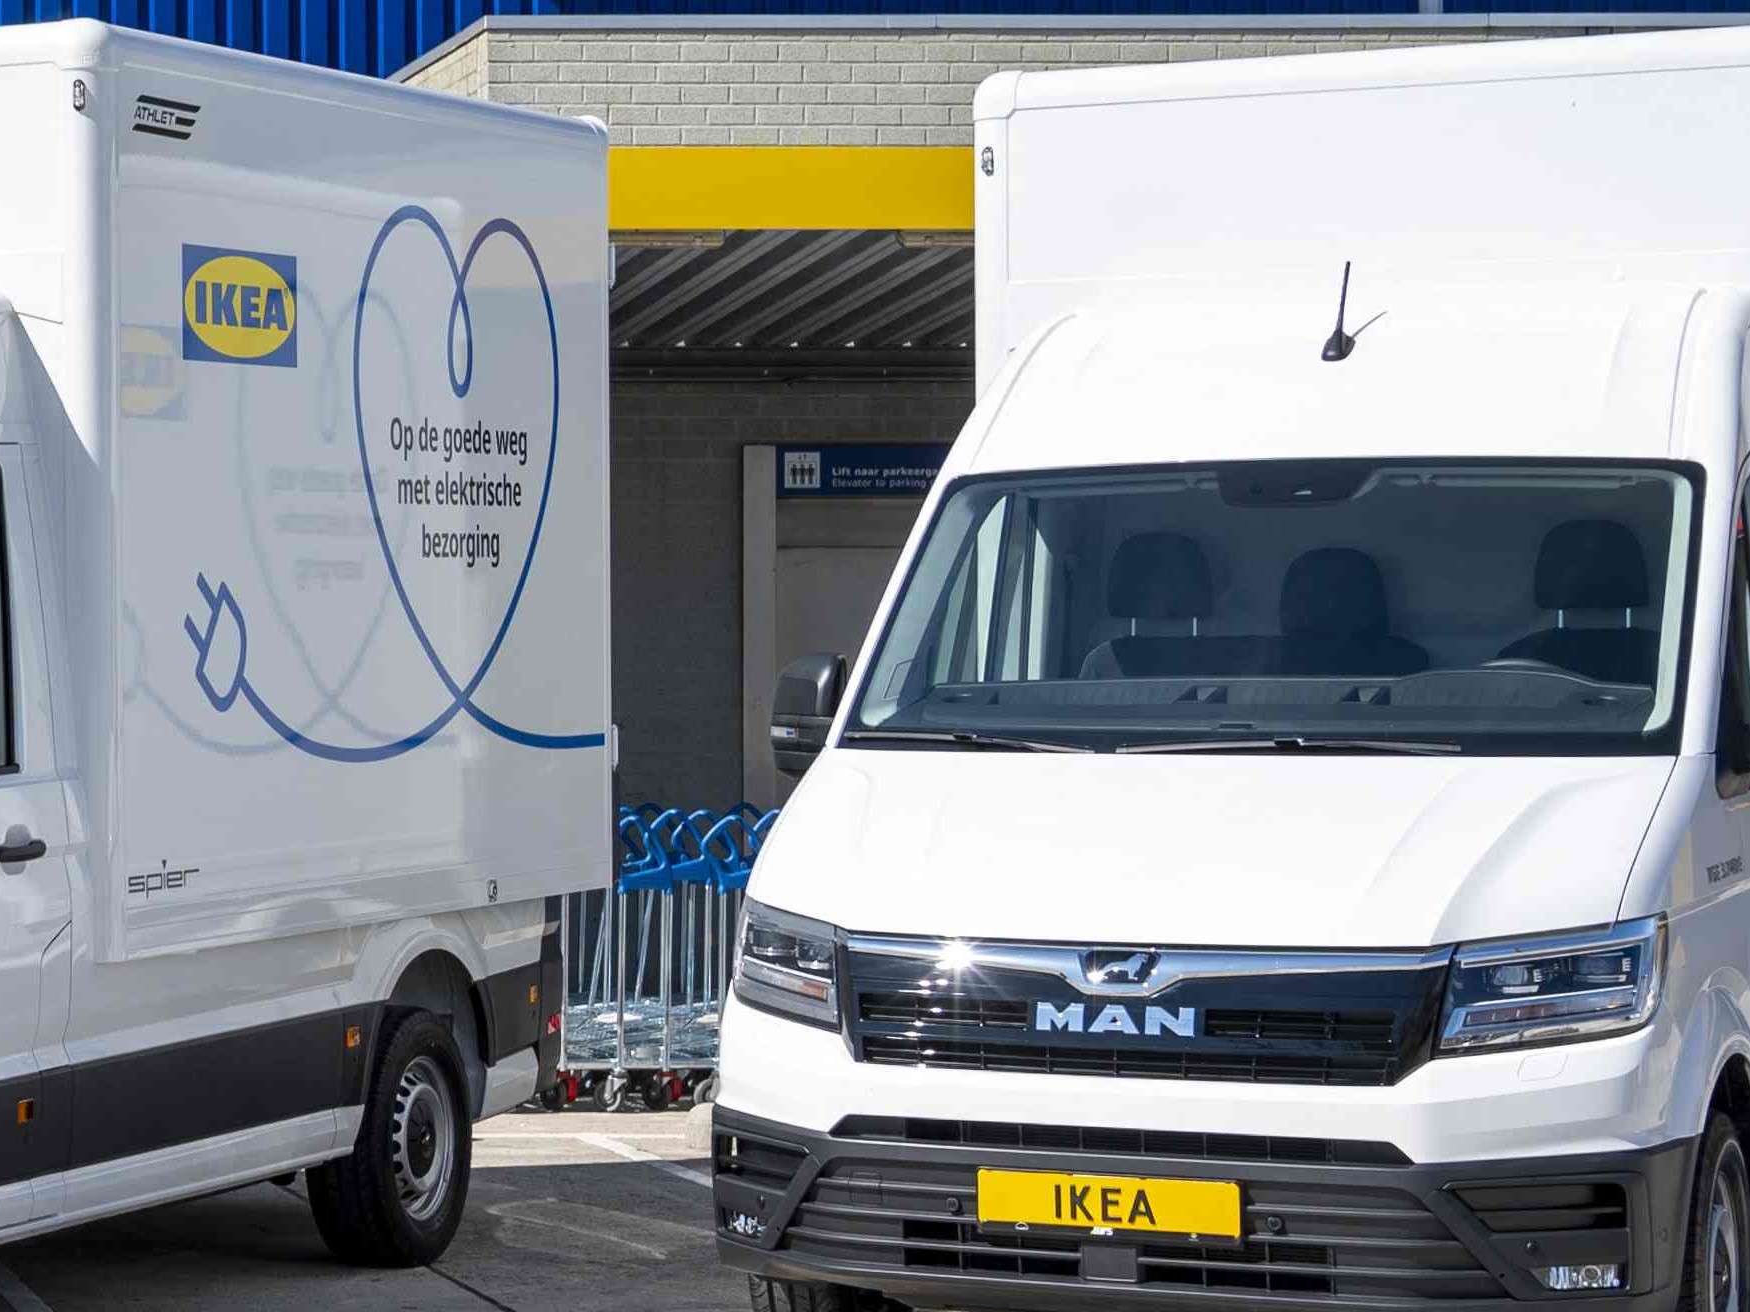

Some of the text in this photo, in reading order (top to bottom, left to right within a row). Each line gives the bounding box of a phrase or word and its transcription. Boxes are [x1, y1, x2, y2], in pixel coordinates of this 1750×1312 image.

[133, 105, 176, 126] ATHLET
[195, 280, 289, 331] IKEA
[390, 417, 528, 466] Op de goede weg
[397, 474, 431, 505] met
[435, 471, 522, 507] elektrische
[832, 467, 939, 478] Lift naar parkeerga
[422, 523, 501, 569] bezorging
[128, 859, 200, 899] spier
[1036, 1001, 1195, 1038] MAN
[1054, 1184, 1156, 1225] IKEA
